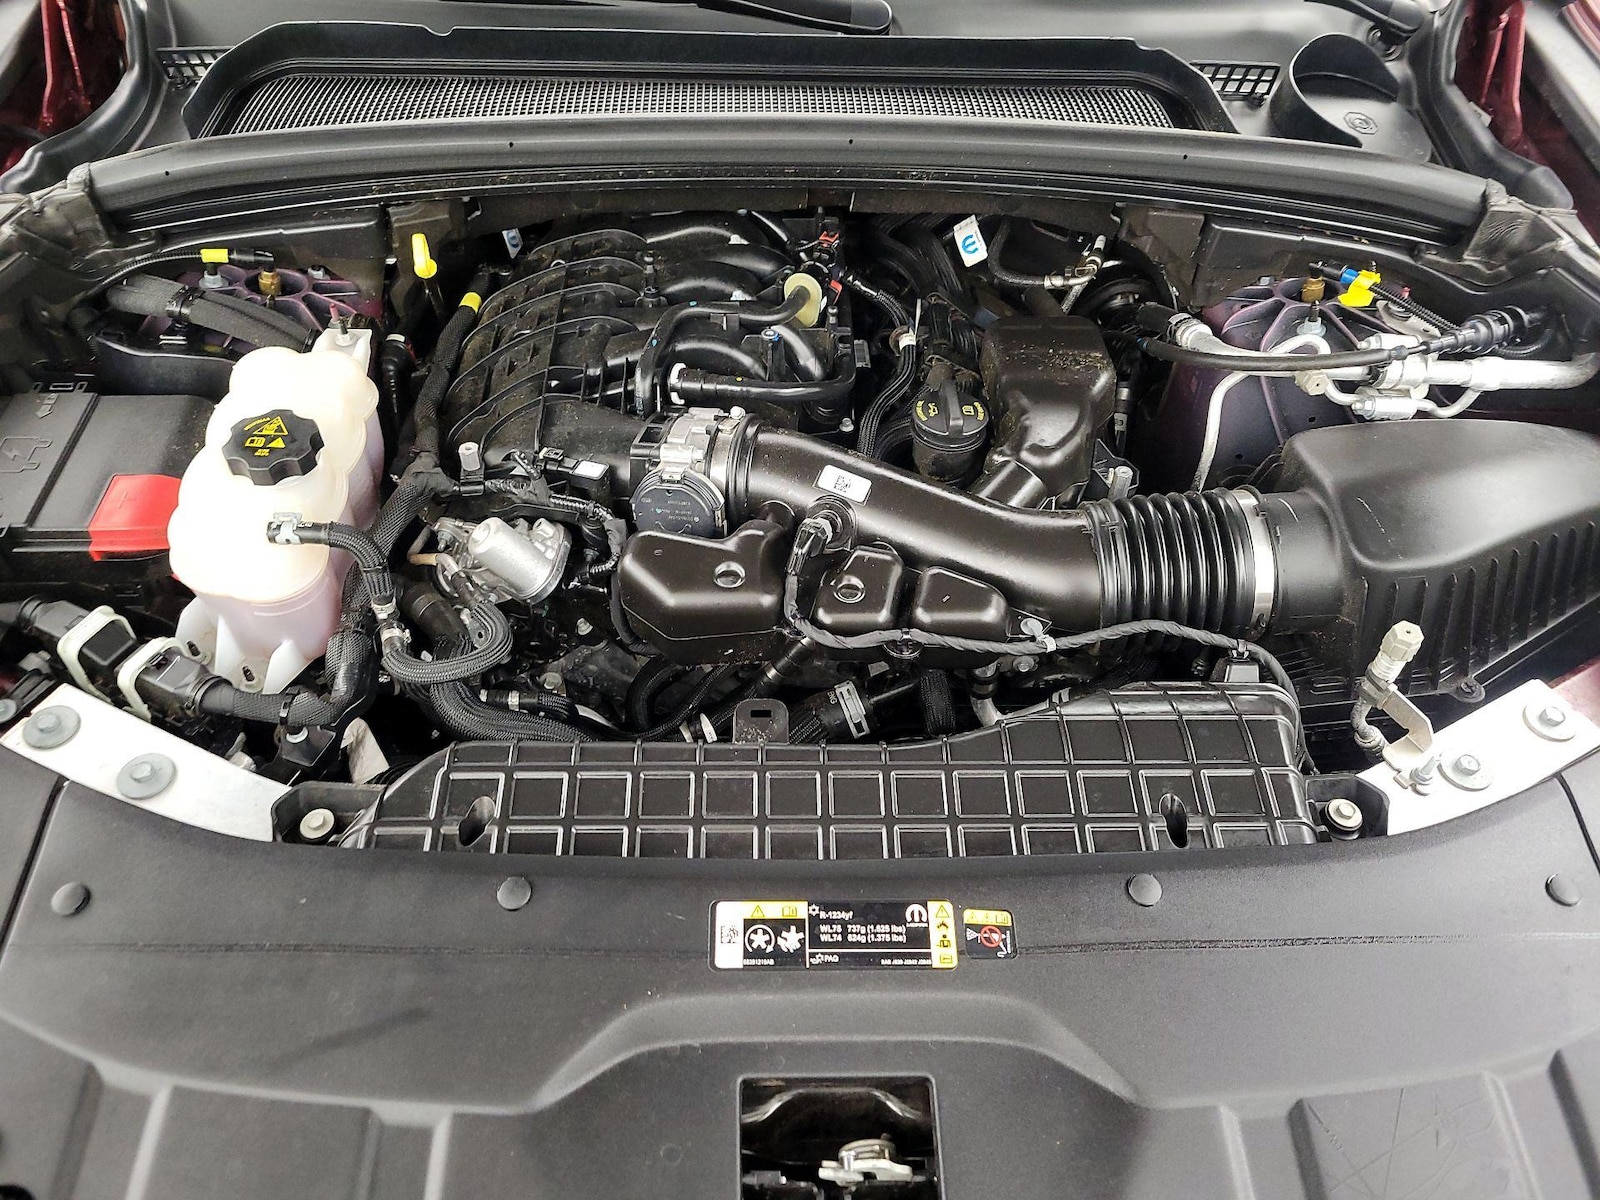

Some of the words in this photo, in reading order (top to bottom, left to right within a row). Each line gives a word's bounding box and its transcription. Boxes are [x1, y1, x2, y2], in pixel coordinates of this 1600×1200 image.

[820, 911, 853, 920] R-1234yf
[847, 924, 866, 934] 737g
[891, 924, 906, 934] lbs)
[819, 933, 842, 942] WL74
[867, 933, 891, 943] (1.375
[891, 933, 907, 943] lbs)
